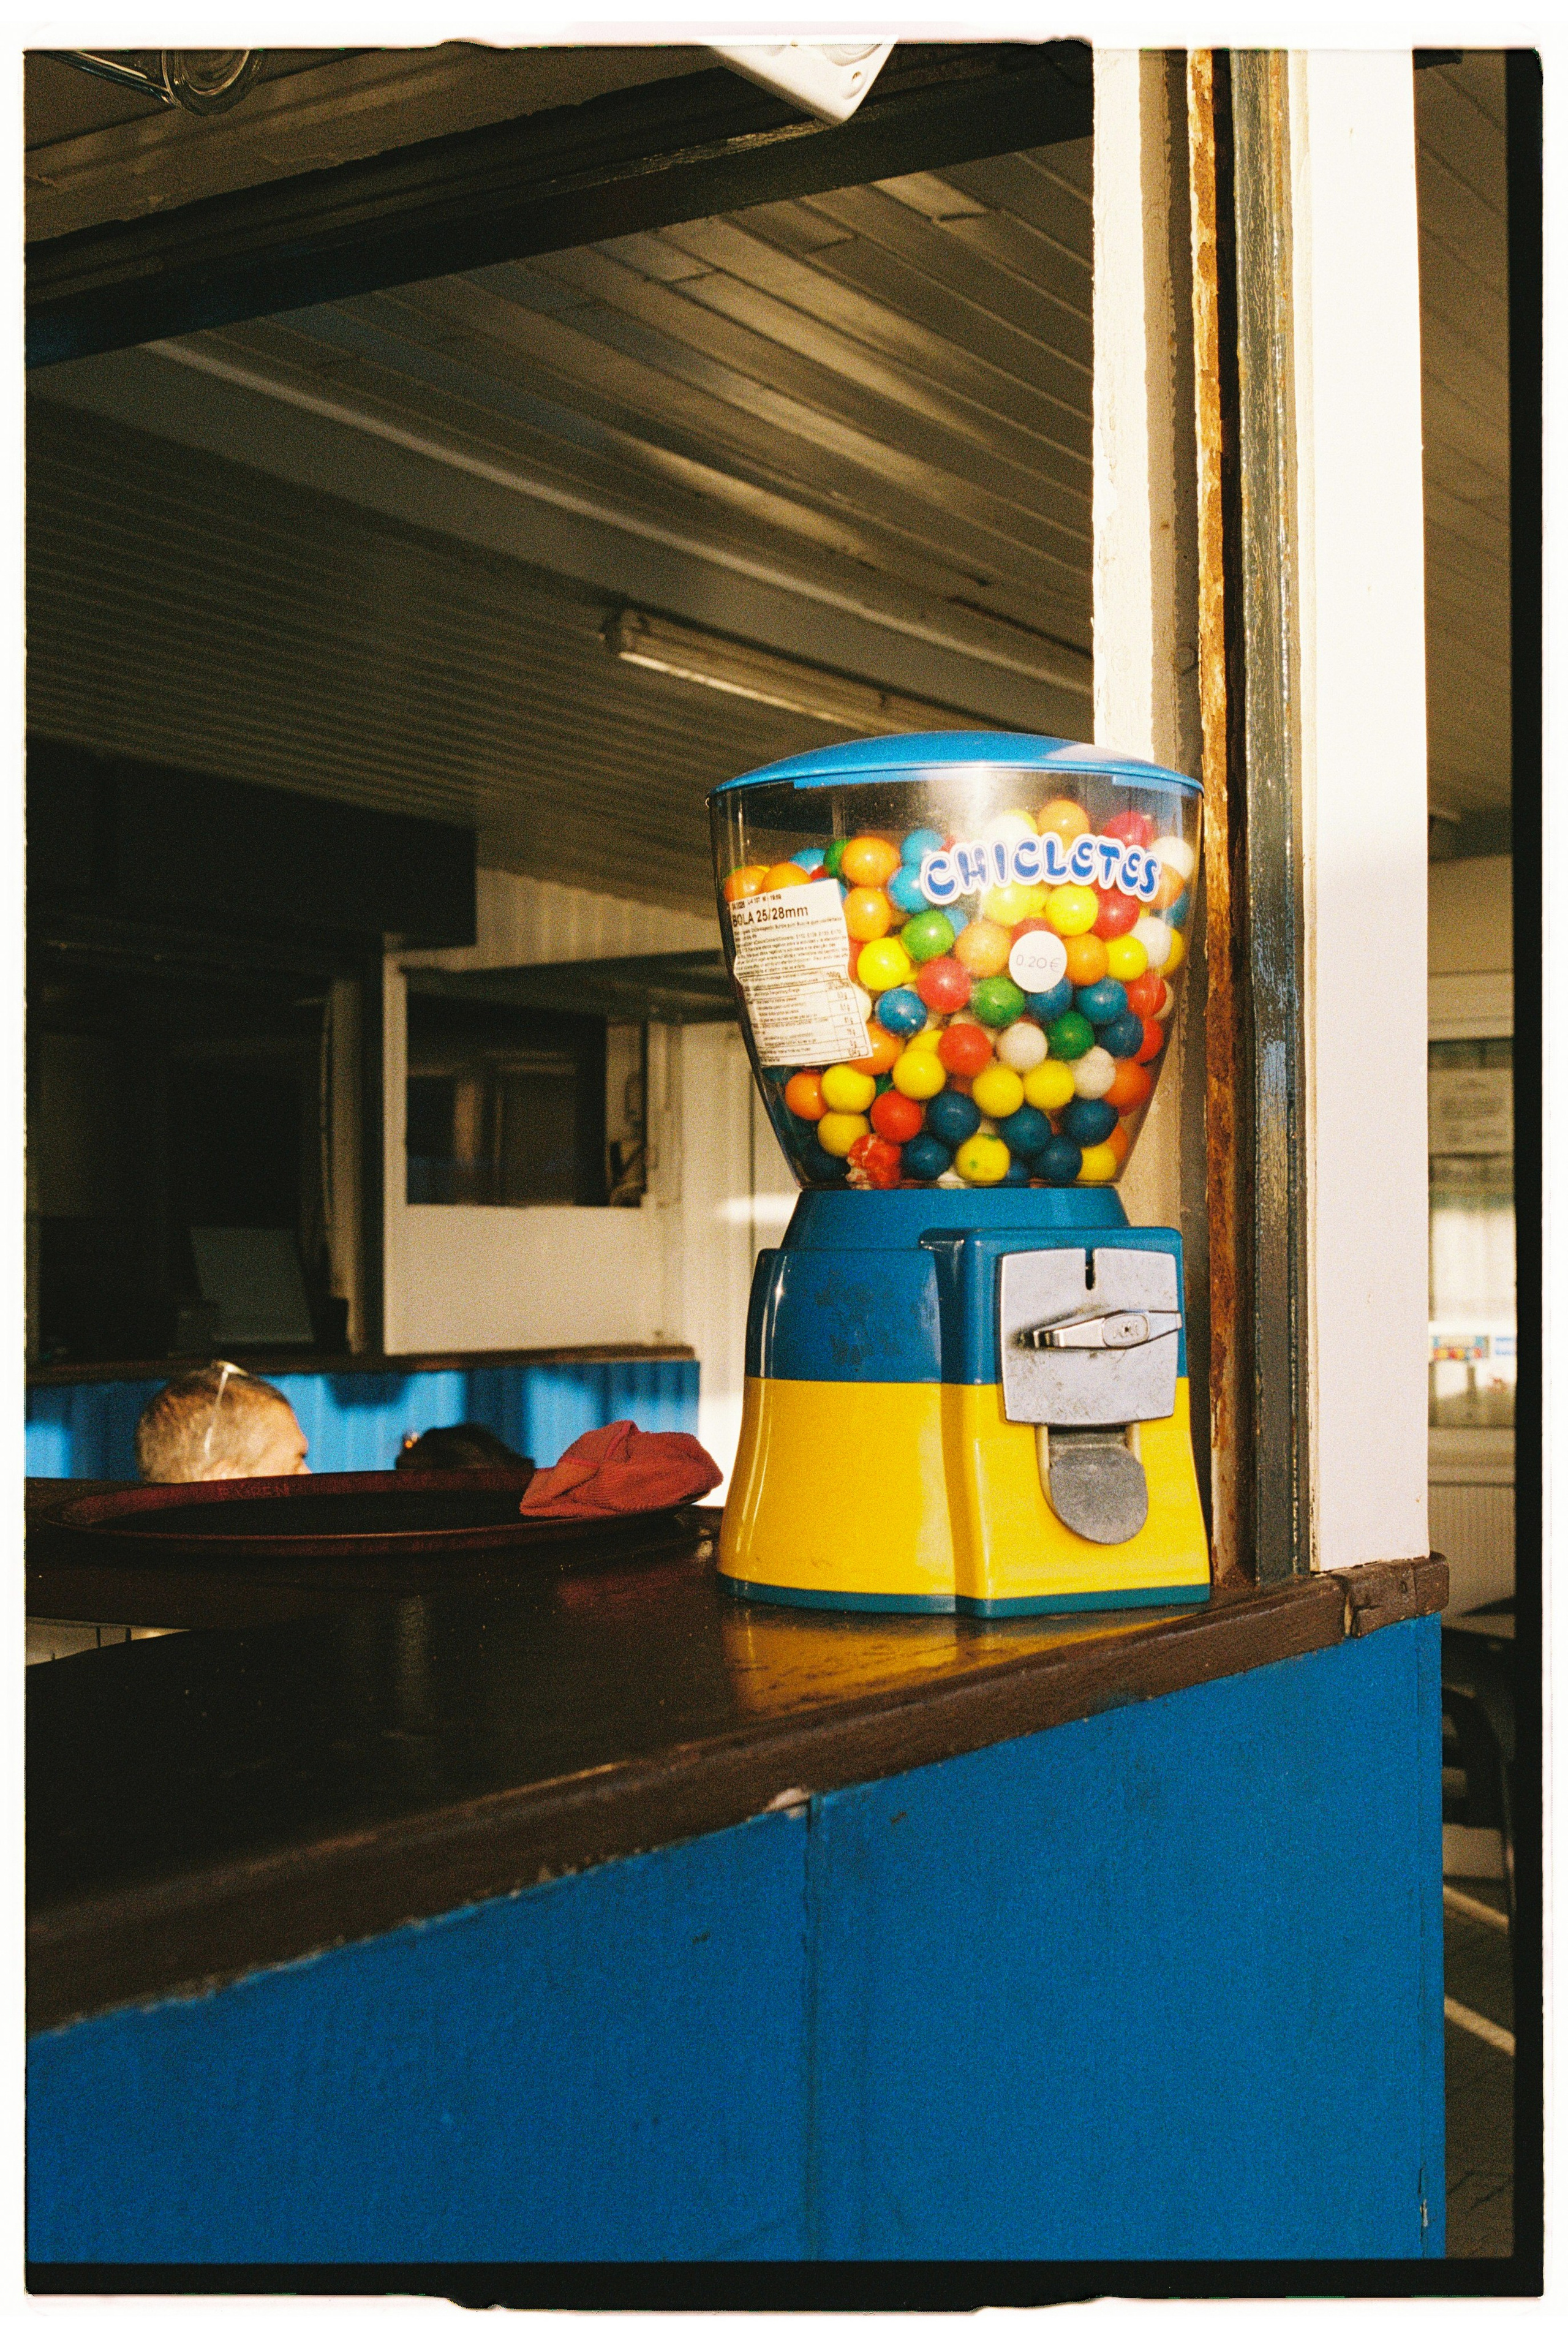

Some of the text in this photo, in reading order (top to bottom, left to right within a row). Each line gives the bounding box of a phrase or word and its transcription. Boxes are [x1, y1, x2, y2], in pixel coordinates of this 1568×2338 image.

[926, 839, 1158, 897] CHICLETES
[732, 907, 809, 927] BOLA 25/28mm
